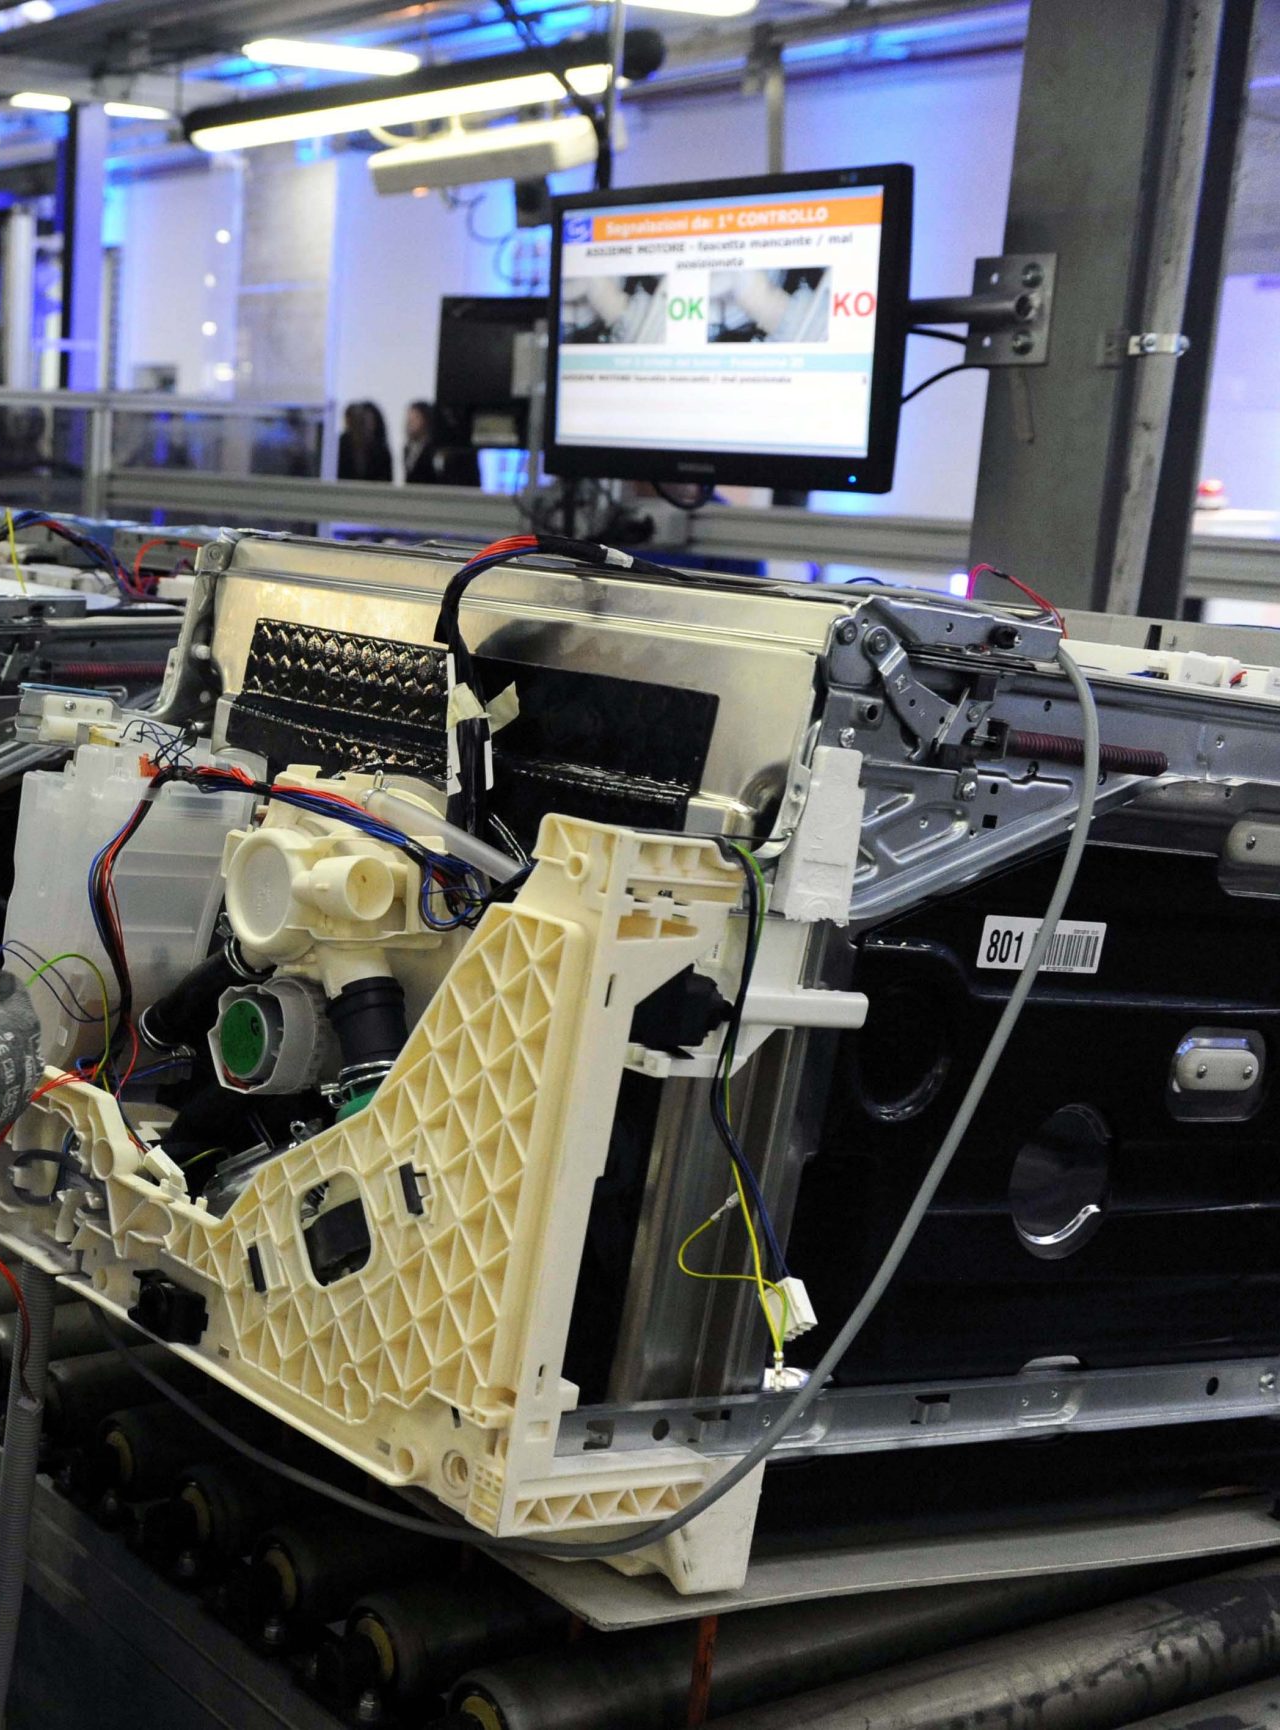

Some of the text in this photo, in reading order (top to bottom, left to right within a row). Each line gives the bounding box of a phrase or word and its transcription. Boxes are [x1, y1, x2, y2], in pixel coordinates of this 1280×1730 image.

[736, 207, 829, 228] CONTROLLO
[637, 242, 685, 254] MOTORE
[750, 235, 812, 248] mancante
[828, 232, 853, 244] mal
[668, 297, 704, 320] OK
[833, 291, 876, 317] KO
[986, 929, 1024, 963] 801
